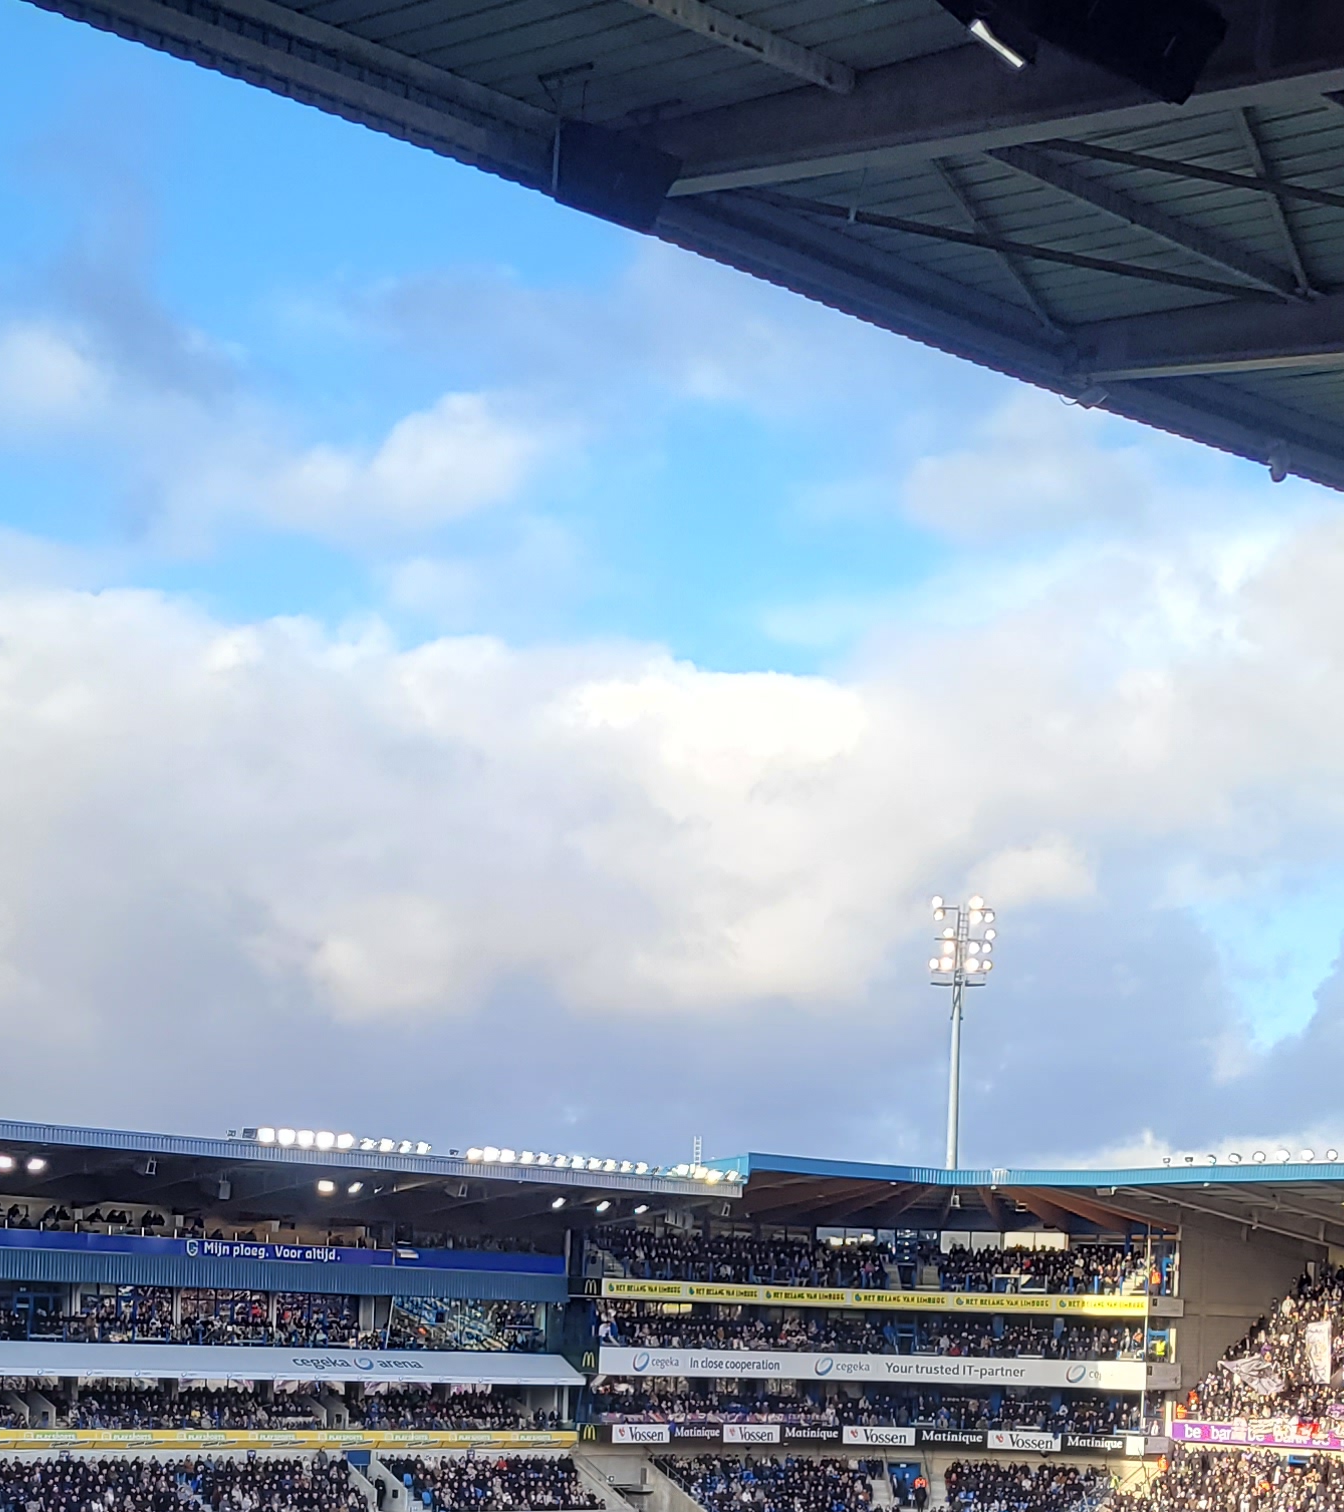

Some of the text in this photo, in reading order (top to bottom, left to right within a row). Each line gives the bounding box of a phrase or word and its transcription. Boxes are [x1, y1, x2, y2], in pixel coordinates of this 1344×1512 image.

[203, 1241, 341, 1263] Mijn ploeg. Voor altijd.
[292, 1357, 424, 1370] cegeka arena
[651, 1357, 780, 1373] cegeka In close cooperation
[836, 1361, 1026, 1380] cegeka Your trusted IT-partner
[629, 1427, 664, 1441] Vossen
[738, 1427, 774, 1442] Vossen
[864, 1429, 907, 1445] Vossen
[1184, 1424, 1233, 1441] beoba
[1009, 1433, 1053, 1449] Vossen
